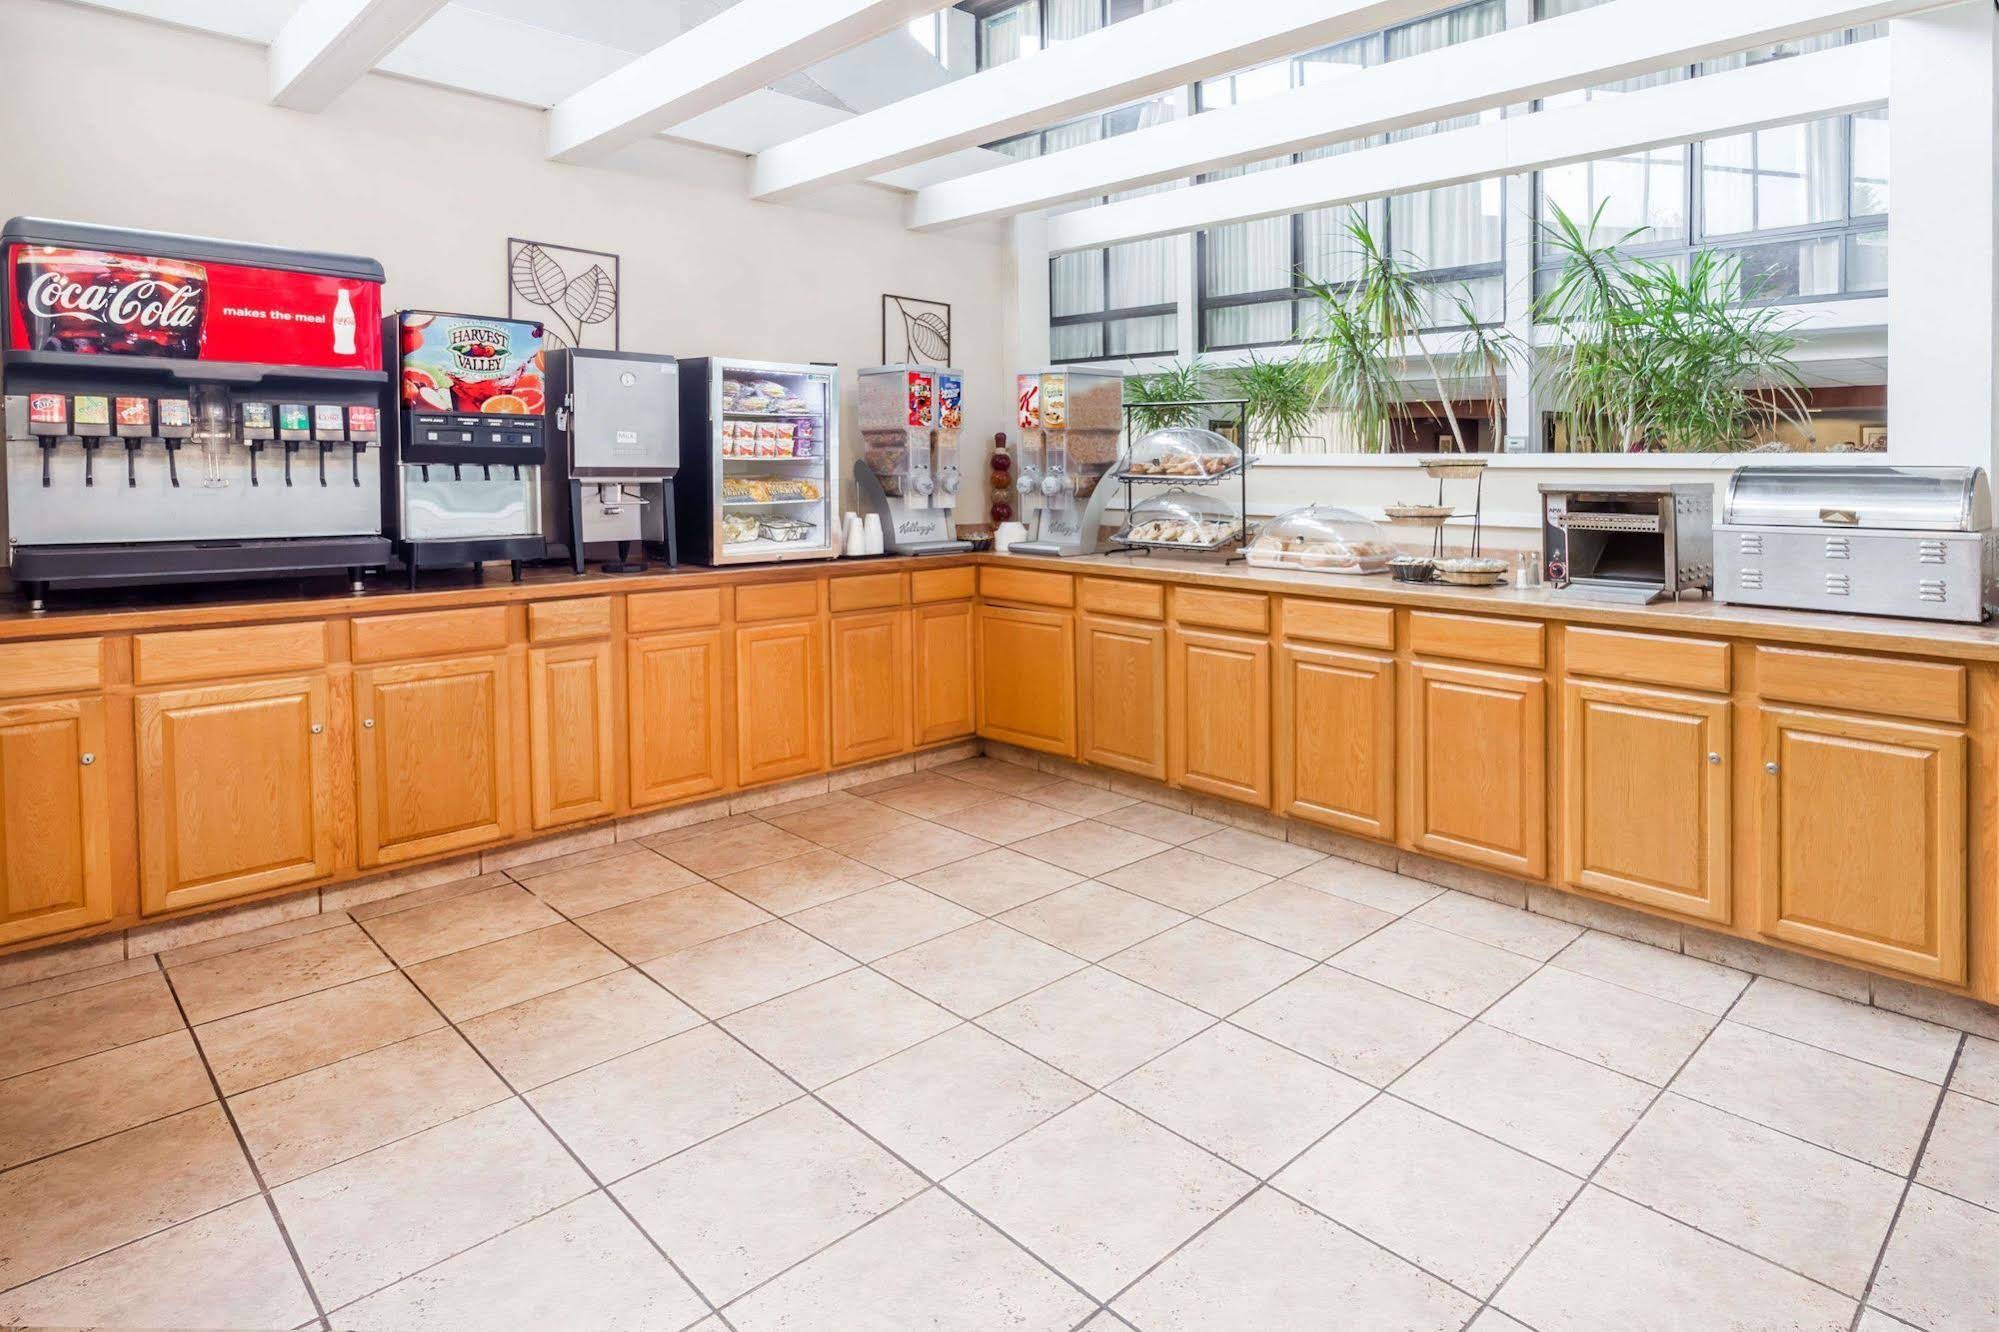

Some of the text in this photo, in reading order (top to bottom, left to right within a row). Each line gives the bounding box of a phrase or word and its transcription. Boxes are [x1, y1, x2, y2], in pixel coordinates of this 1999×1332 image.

[27, 272, 201, 327] Coca-Cola
[223, 307, 267, 319] makes
[270, 310, 292, 321] the
[295, 313, 325, 323] meal
[453, 329, 508, 347] HARVEST
[457, 354, 502, 371] VALLEY
[899, 521, 936, 536] Kellogg's
